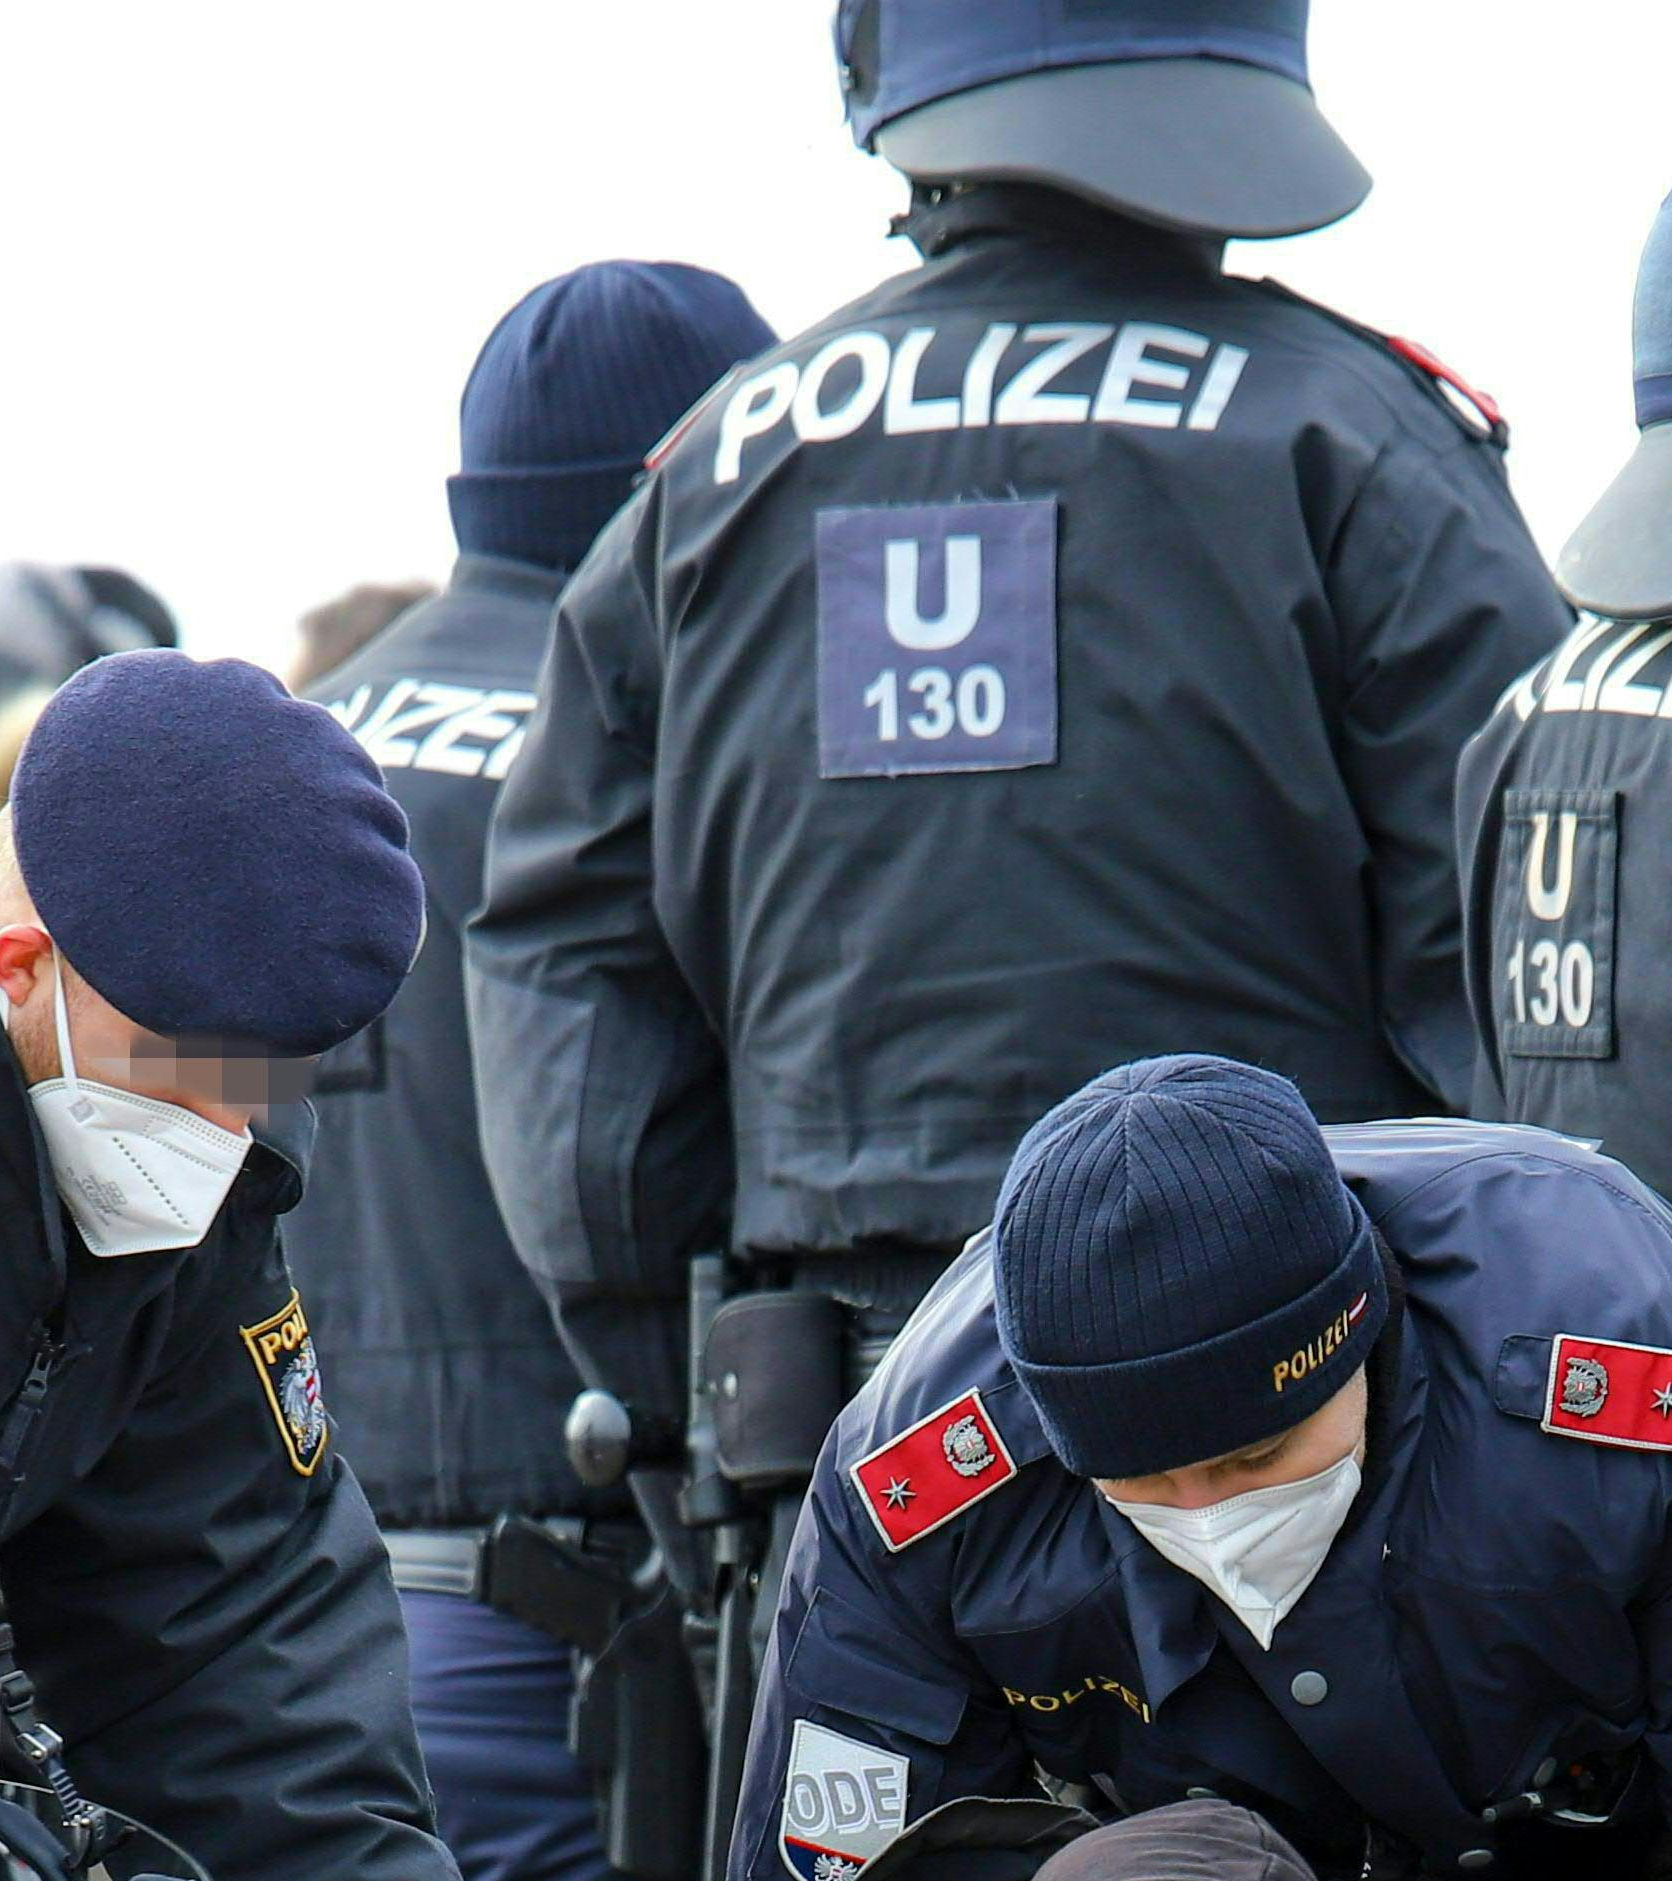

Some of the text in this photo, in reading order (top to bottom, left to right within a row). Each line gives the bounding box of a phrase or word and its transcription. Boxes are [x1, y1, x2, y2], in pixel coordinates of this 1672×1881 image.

[712, 322, 1250, 484] POLIZEI
[882, 535, 983, 651] U
[862, 664, 1007, 742] 130
[1530, 811, 1578, 921] U
[1507, 940, 1594, 1027] 130
[1273, 1309, 1348, 1393] POLIZEI
[1002, 1675, 1150, 1724] POLIZEI
[787, 1766, 900, 1837] ODE
